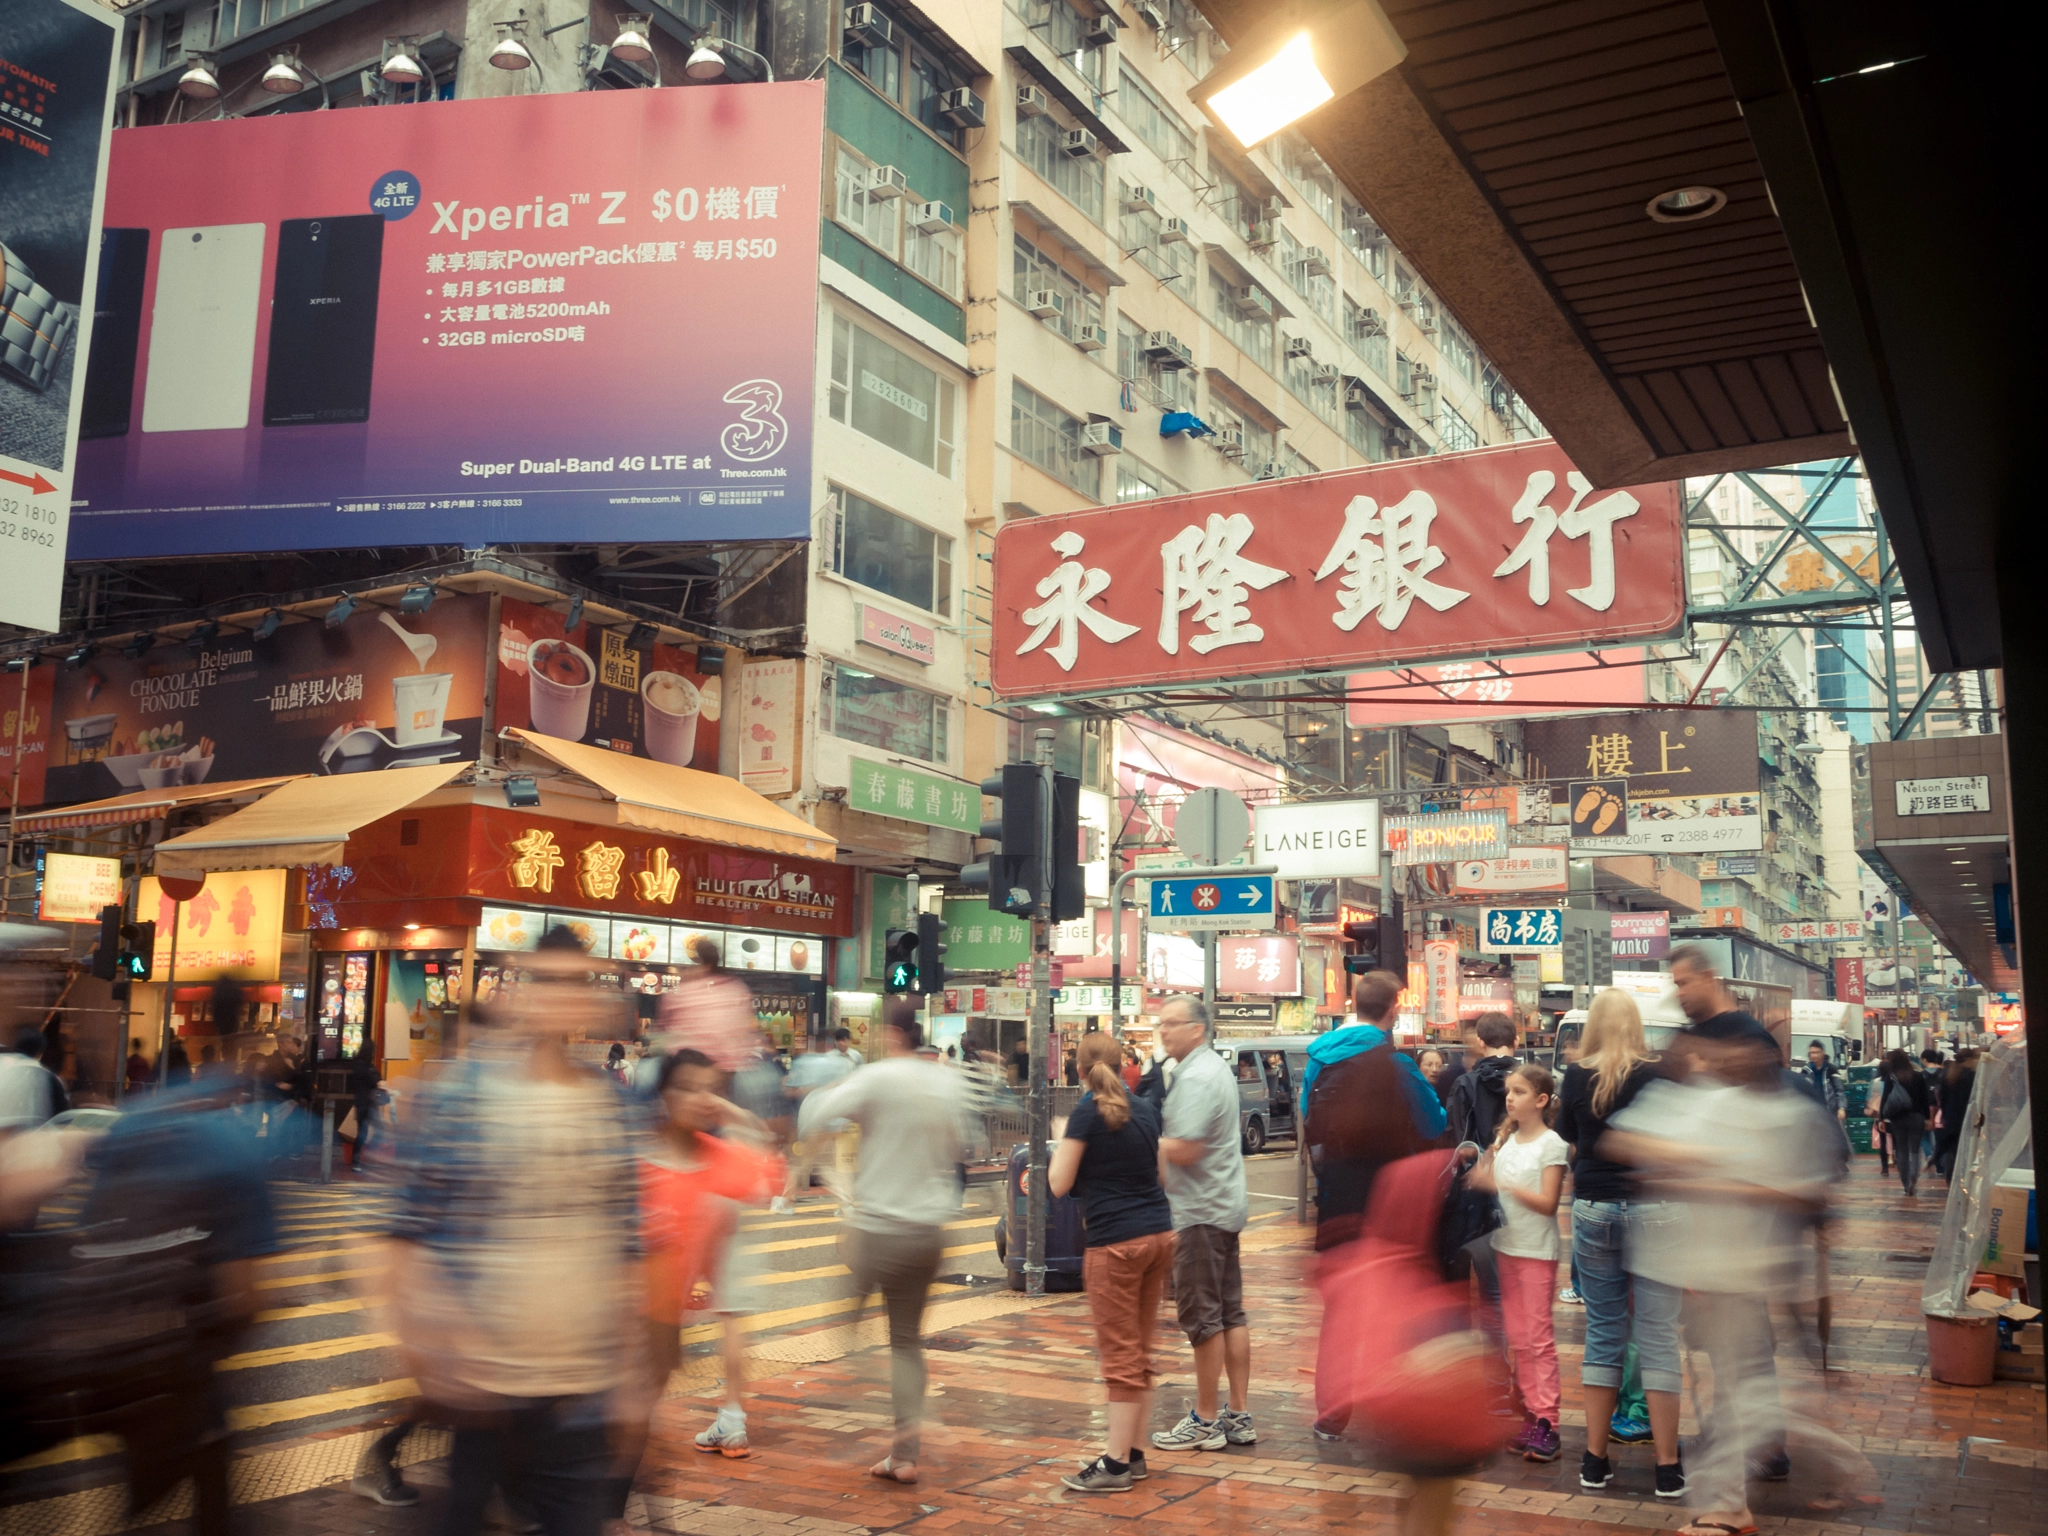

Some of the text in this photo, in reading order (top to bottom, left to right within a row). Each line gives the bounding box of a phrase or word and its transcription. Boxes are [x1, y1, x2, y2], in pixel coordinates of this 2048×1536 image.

[18, 132, 50, 156] TIME
[384, 181, 408, 196] 全新
[374, 194, 415, 209] 4G LTE
[598, 191, 627, 225] Z
[693, 237, 777, 262] 每月$50
[441, 276, 565, 298] 每月多1GB數據
[309, 297, 342, 305] XPERIA
[440, 301, 611, 324] 大容量電池5200mAh
[437, 325, 586, 347] 32GB microSD咭
[460, 455, 712, 479] Super Dual-Band 4G LTE at
[720, 467, 787, 479] Three.com.hk
[407, 502, 426, 510] 2222
[503, 499, 522, 507] 3333
[609, 495, 681, 505] www.three.com.hk
[0, 498, 19, 515] 32
[26, 504, 57, 525] 1810
[21, 527, 55, 548] 8962
[1016, 469, 1641, 672] 永隆銀行
[880, 626, 899, 643] salon
[201, 647, 253, 671] Belgium
[130, 668, 218, 698] CHOCOLATE
[253, 673, 364, 712] 一品鮮果火鍋
[1437, 662, 1514, 707] 莎莎
[140, 689, 200, 714] FONDUE
[868, 770, 968, 823] 春藤書坊
[1628, 787, 1670, 798] .hkjebn.com
[1903, 781, 1983, 794] Nelson Street
[1910, 795, 1976, 811] 奶路臣街
[1264, 827, 1367, 852] LANEIGE
[1413, 824, 1496, 847] BONJOUR
[1678, 831, 1709, 843] 2388
[1712, 828, 1743, 840] 4977
[96, 863, 111, 878] BEE
[507, 828, 681, 905] 許留山
[89, 882, 116, 897] CHENG
[696, 895, 834, 920] HEALTHY DESSERT
[1057, 924, 1090, 939] EIGE
[1170, 917, 1198, 927] 旺角站
[1611, 918, 1656, 928] ourmix
[949, 925, 1024, 944] 春藤書坊
[217, 950, 256, 967] HIANG
[1234, 946, 1282, 982] 莎莎
[1459, 1003, 1498, 1012] ourmix
[1989, 1208, 2004, 1261] Bonaqua
